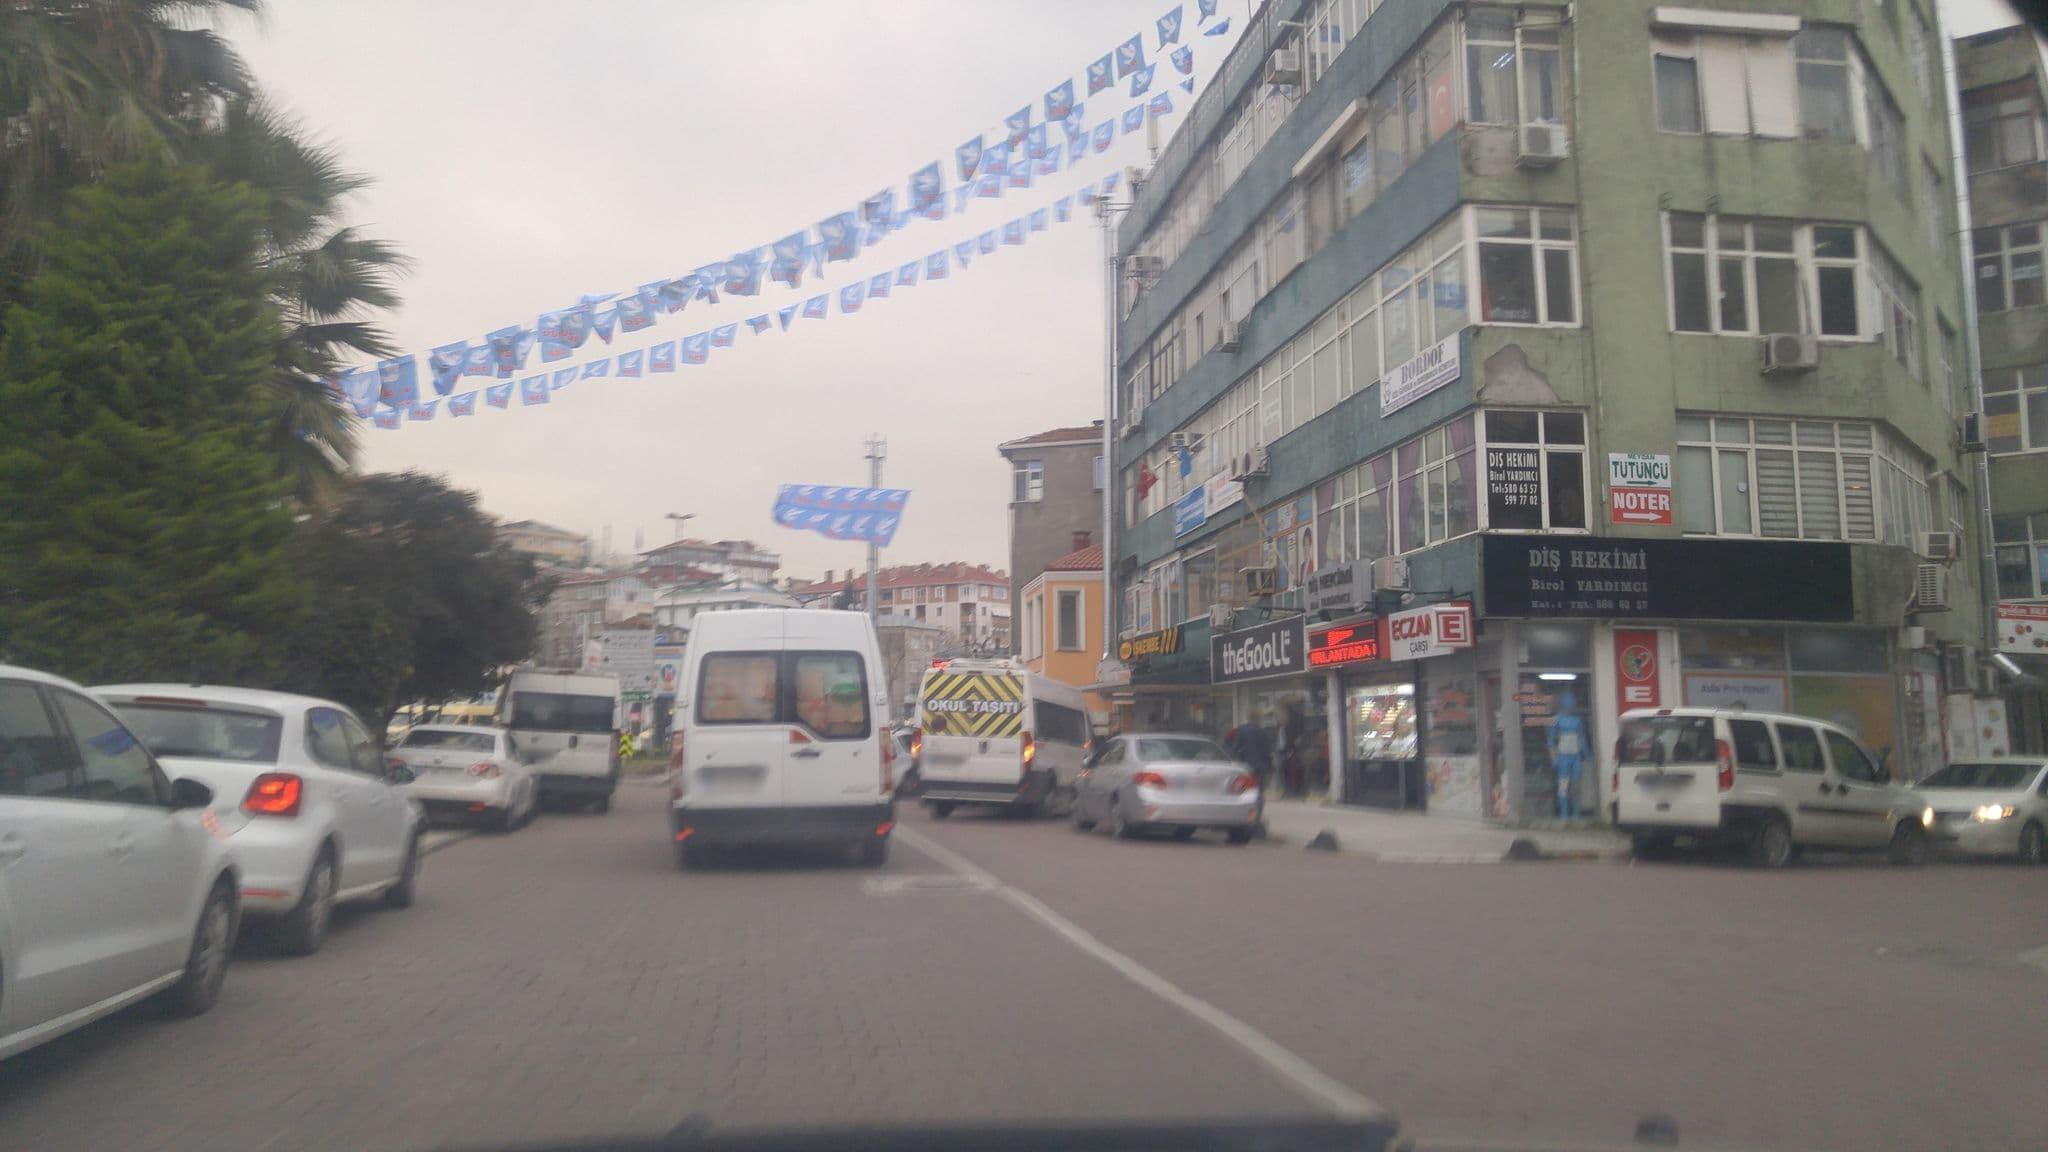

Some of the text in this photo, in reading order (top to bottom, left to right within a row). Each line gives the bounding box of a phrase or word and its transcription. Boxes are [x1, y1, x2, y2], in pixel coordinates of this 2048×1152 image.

[1489, 452, 1537, 468] DİŞ HEKİMİ
[1506, 470, 1538, 482] YARDIMCI
[1613, 492, 1671, 511] NOTER
[1528, 546, 1648, 572] DİŞ HEKİMİ
[1531, 579, 1648, 592] Birol YARDIMCI
[1442, 615, 1462, 639] E
[927, 700, 1018, 716] OKUL TAŞITI
